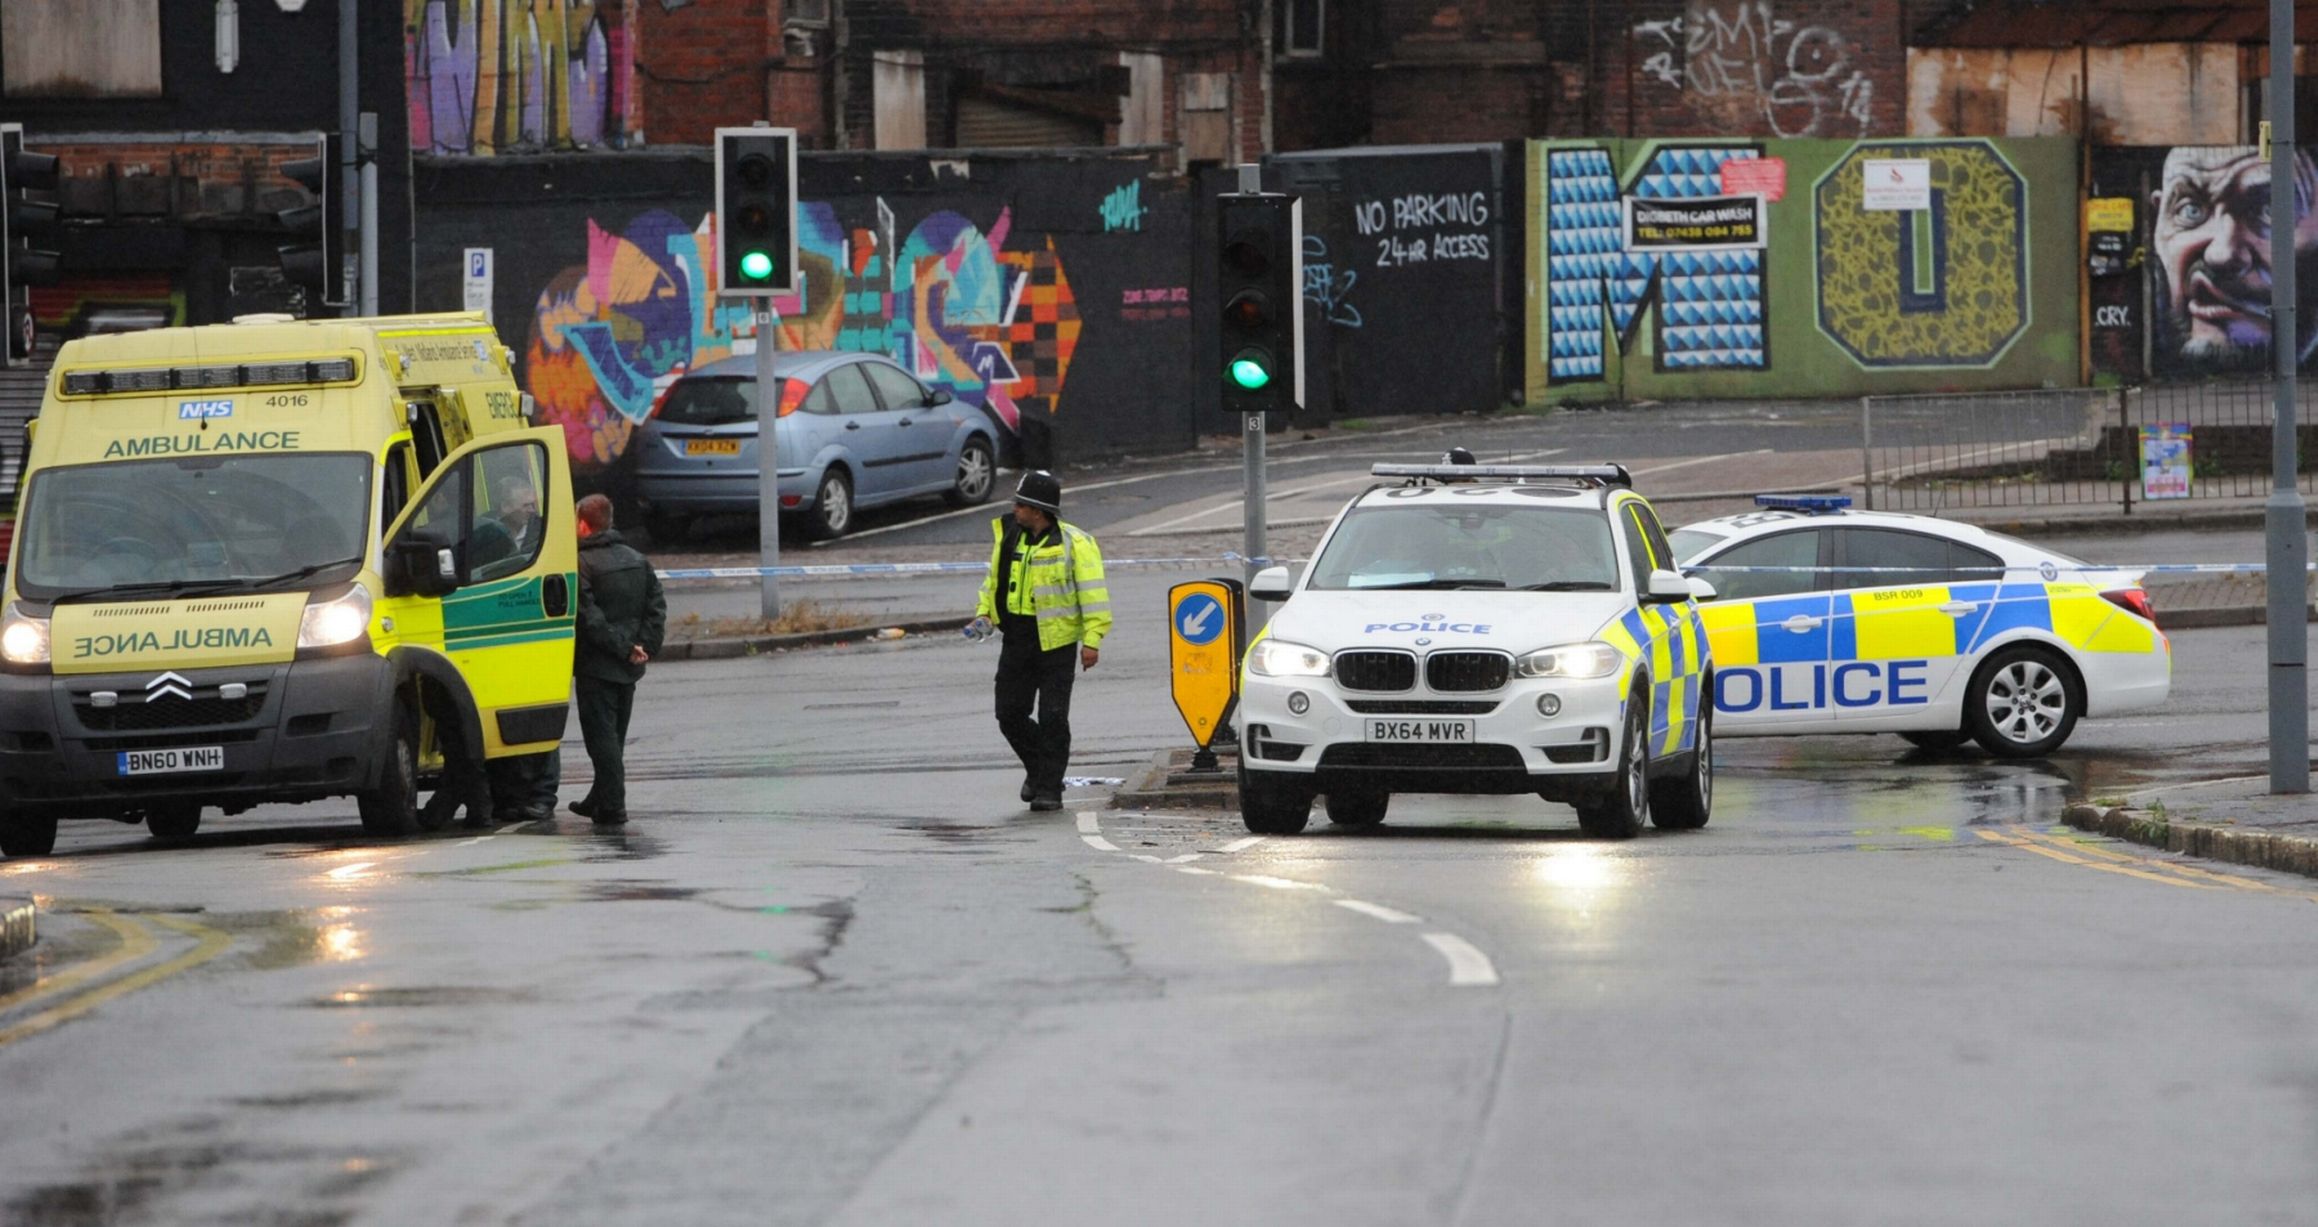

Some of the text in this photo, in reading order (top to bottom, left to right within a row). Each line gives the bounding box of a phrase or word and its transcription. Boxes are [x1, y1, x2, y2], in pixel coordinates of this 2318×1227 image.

[1356, 191, 1488, 235] NO PARKING
[1636, 207, 1752, 224] DIGBETH CAR WASH
[1638, 227, 1664, 239] TEL:
[1433, 233, 1489, 260] ACCESS
[473, 254, 483, 276] P
[179, 400, 232, 419] NHS
[265, 394, 309, 408] 4016
[1250, 417, 1259, 430] 3
[104, 431, 301, 459] AMBULANCE
[1873, 588, 1924, 602] BSR 009
[1364, 622, 1493, 635] POLICE
[1713, 659, 1929, 714] OLICE
[1374, 722, 1466, 740] BX64 MVR
[129, 748, 219, 771] BN60 WNH
